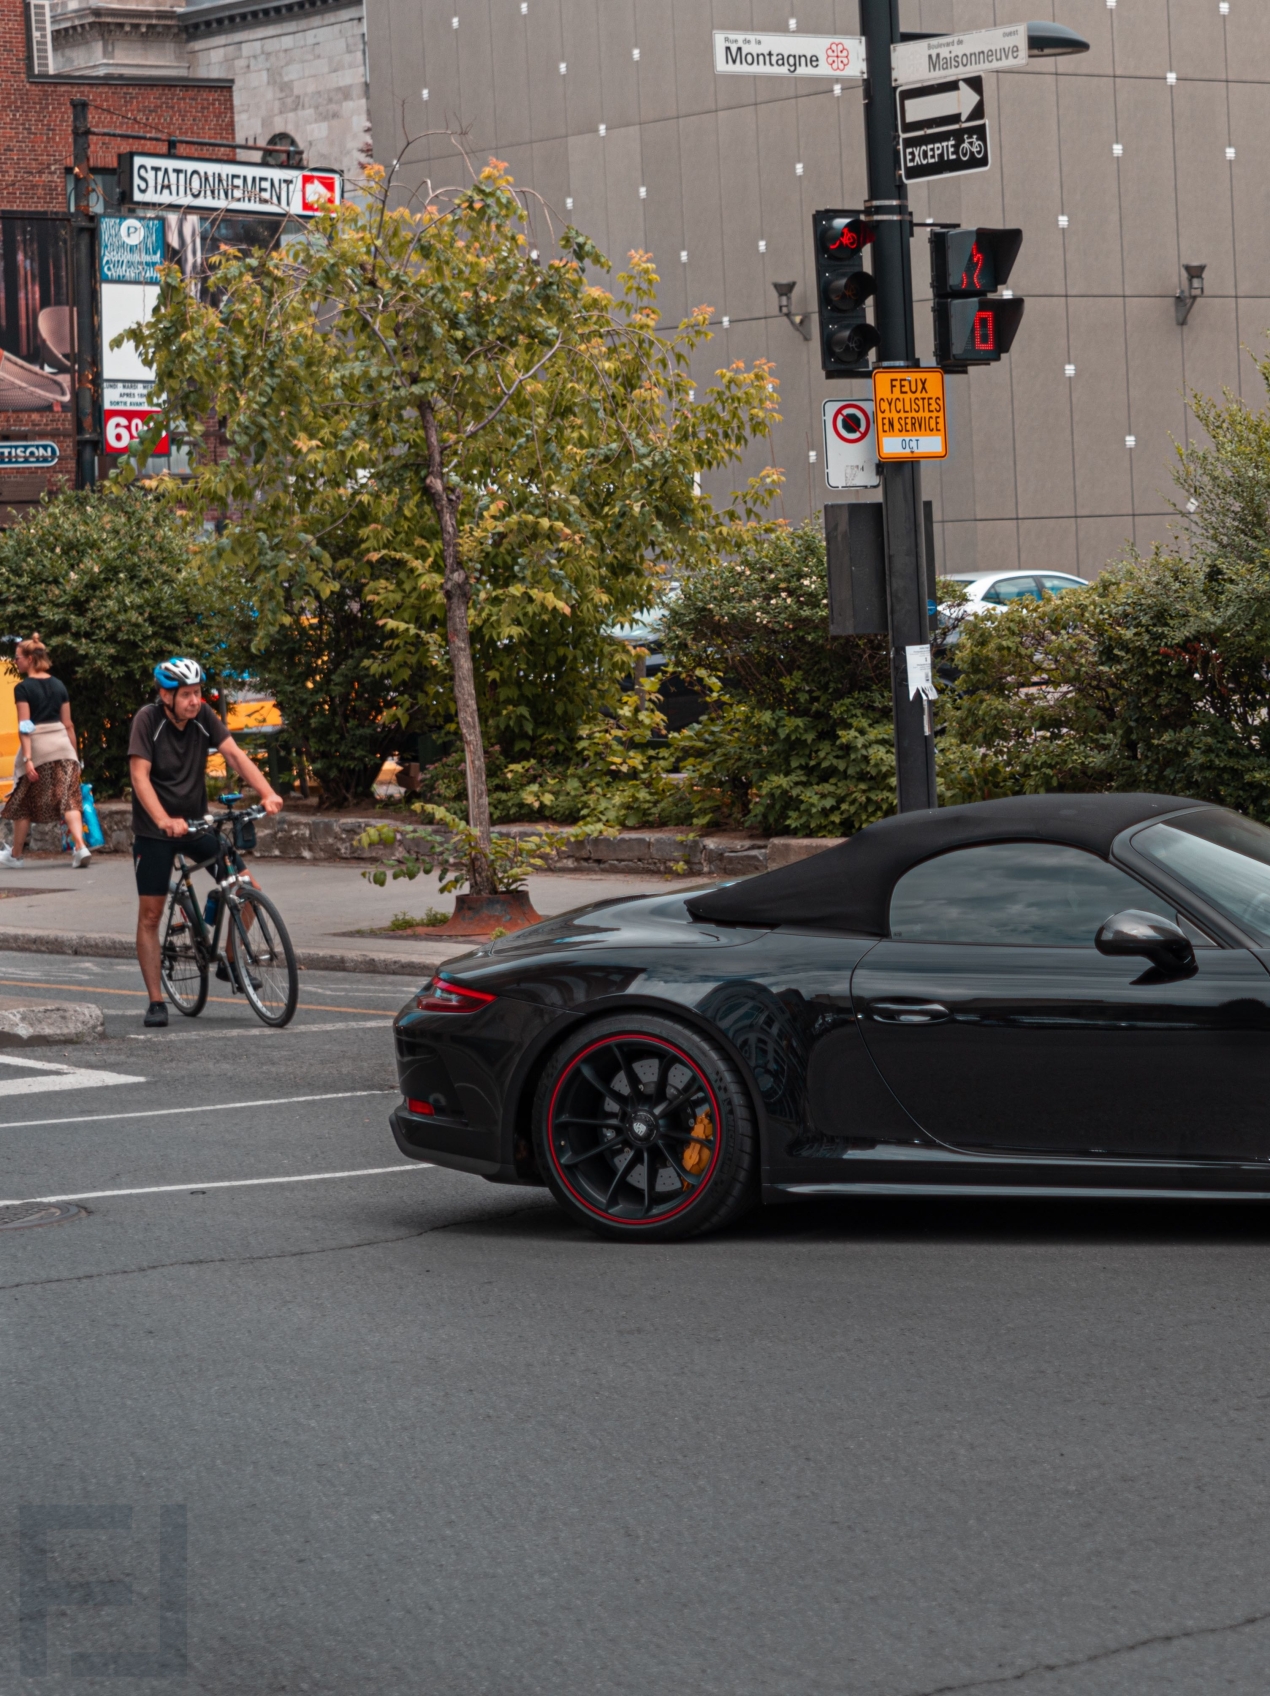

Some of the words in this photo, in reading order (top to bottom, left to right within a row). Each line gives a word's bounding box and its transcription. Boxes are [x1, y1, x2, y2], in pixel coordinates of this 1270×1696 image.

[724, 36, 738, 45] Rue
[742, 37, 751, 45] de
[754, 38, 762, 46] la
[1002, 29, 1019, 38] ouest
[927, 40, 955, 51] Boulevard
[724, 46, 820, 73] Montagne
[928, 44, 1020, 73] Maisonneuve
[906, 136, 957, 167] EXCEPTÉ
[137, 164, 293, 207] STATIONNEMENT
[127, 226, 138, 238] P
[890, 378, 929, 394] FEUX
[879, 397, 942, 414] CYCLISTES
[881, 417, 895, 433] EN
[897, 416, 941, 432] SERVICE
[901, 439, 920, 450] OCT
[0, 446, 52, 462] TISON
